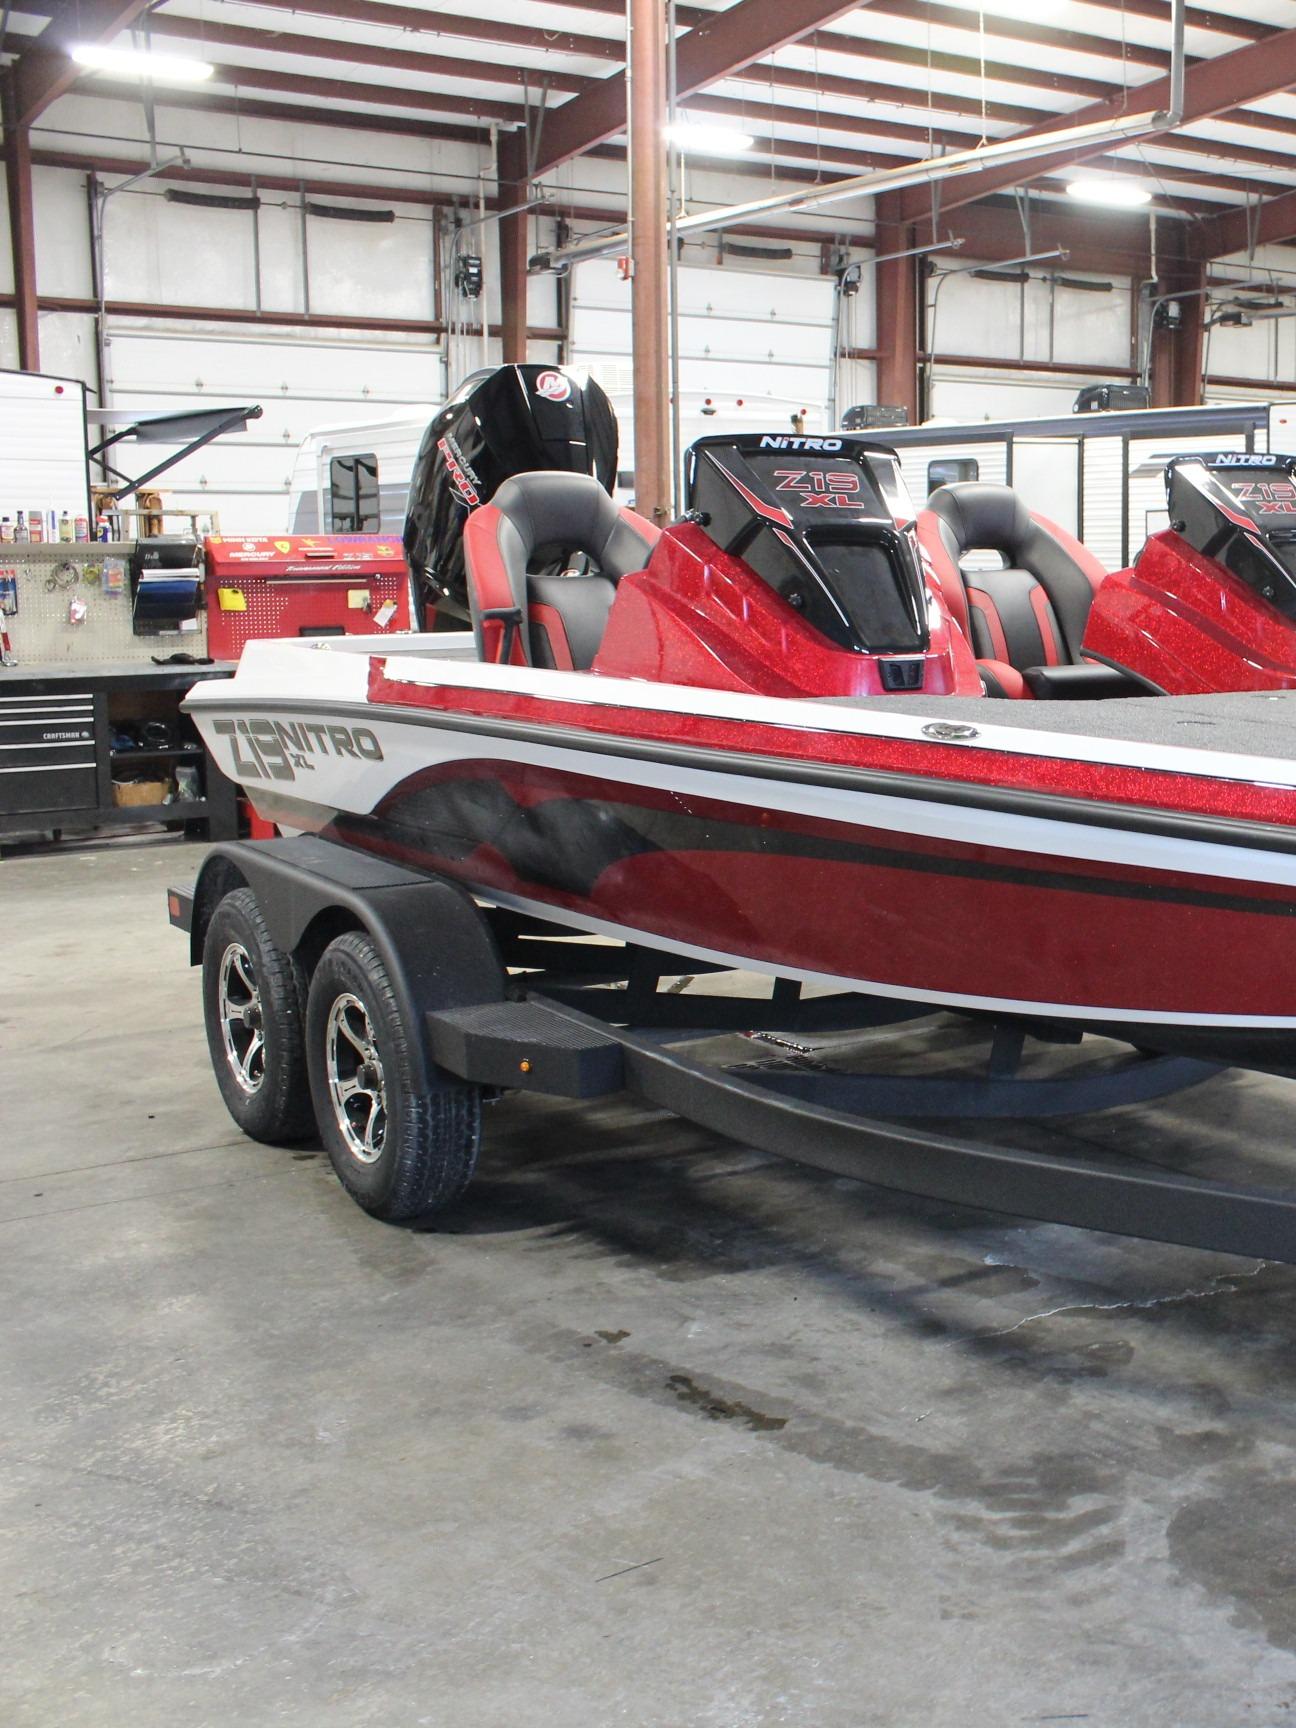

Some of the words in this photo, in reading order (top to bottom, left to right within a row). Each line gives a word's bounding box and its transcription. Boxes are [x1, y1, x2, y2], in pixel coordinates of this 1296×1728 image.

[760, 435, 842, 451] NITRO
[448, 433, 482, 486] MERCURY
[1215, 454, 1277, 466] NITRO
[437, 437, 480, 506] PRO
[773, 470, 860, 493] Z19
[800, 492, 865, 509] XL
[43, 731, 80, 740] CRAFTSMAN
[212, 718, 296, 782] Z19
[272, 720, 385, 762] NITRO
[289, 752, 316, 770] XL
